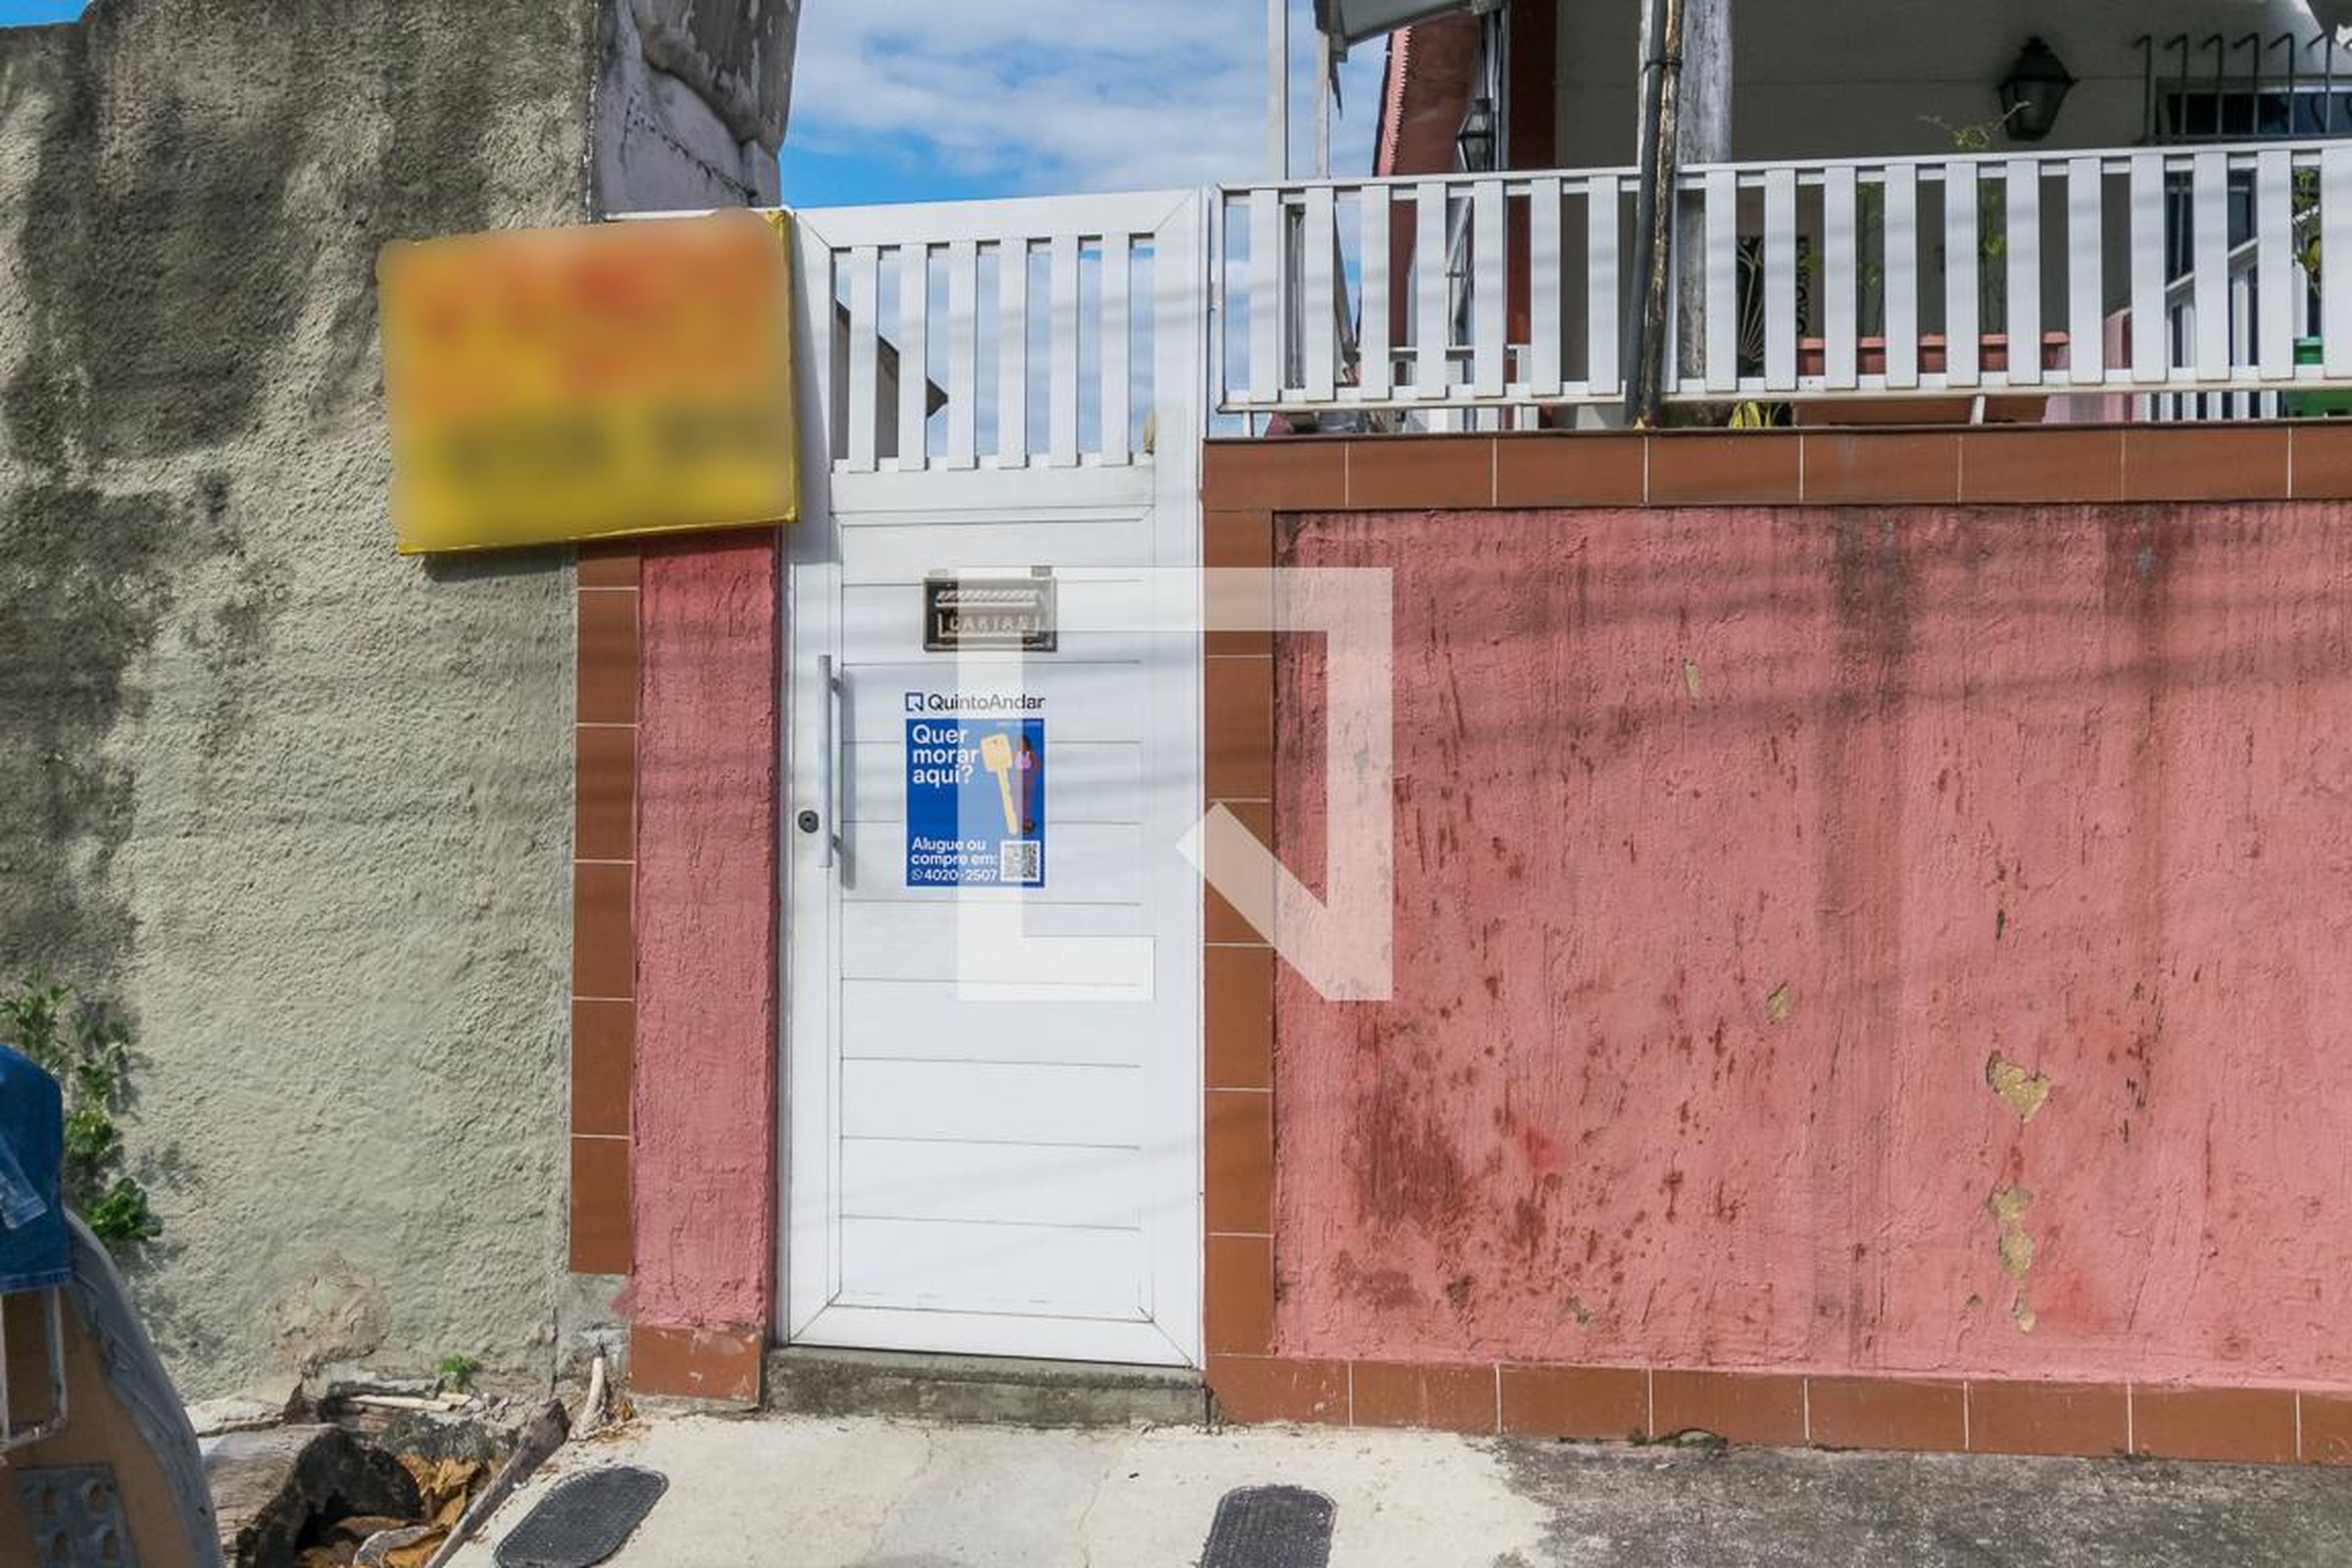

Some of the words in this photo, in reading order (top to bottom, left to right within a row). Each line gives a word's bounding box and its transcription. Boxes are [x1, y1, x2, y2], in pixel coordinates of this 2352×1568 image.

[928, 693, 1046, 710] QuintoAndar
[913, 724, 968, 744] Quer
[913, 748, 979, 764] morar
[913, 765, 973, 788] aqui?
[912, 837, 964, 853] Alugue
[967, 840, 986, 850] ou
[911, 854, 968, 867] compre
